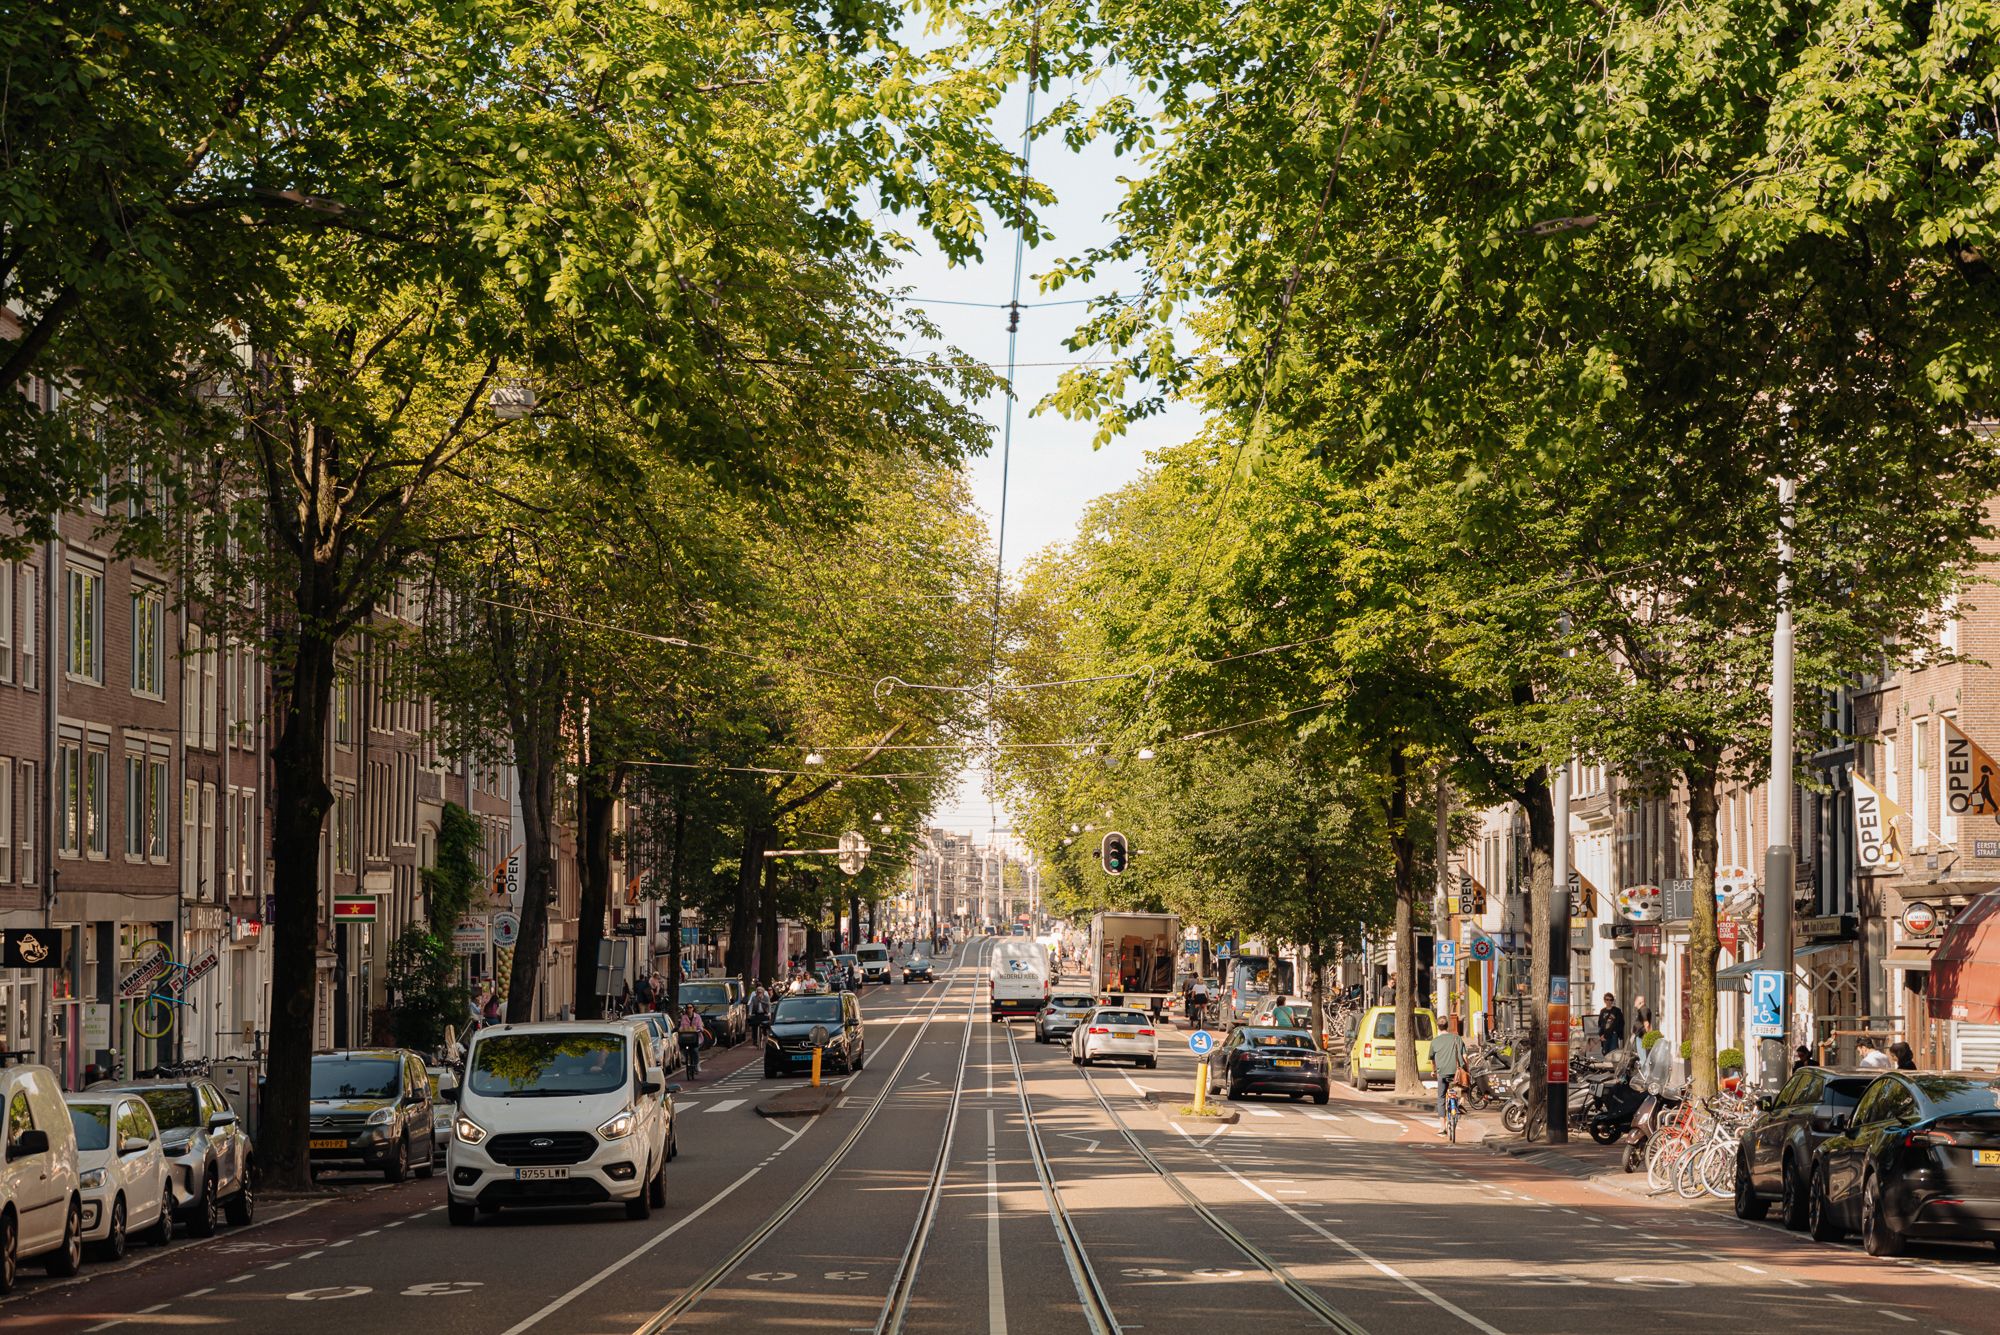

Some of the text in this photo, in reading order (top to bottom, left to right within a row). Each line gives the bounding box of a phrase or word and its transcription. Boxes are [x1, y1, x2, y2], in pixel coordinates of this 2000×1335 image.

[1948, 739, 1969, 813] OPEN
[1858, 796, 1881, 862] OPEN
[508, 856, 519, 892] OPEN
[1462, 878, 1472, 914] OPEN
[197, 907, 213, 928] HAIR
[213, 908, 221, 928] 33
[119, 950, 163, 992] REPARATIES
[1758, 975, 1776, 1003] P
[521, 1169, 566, 1178] 9755 LWW
